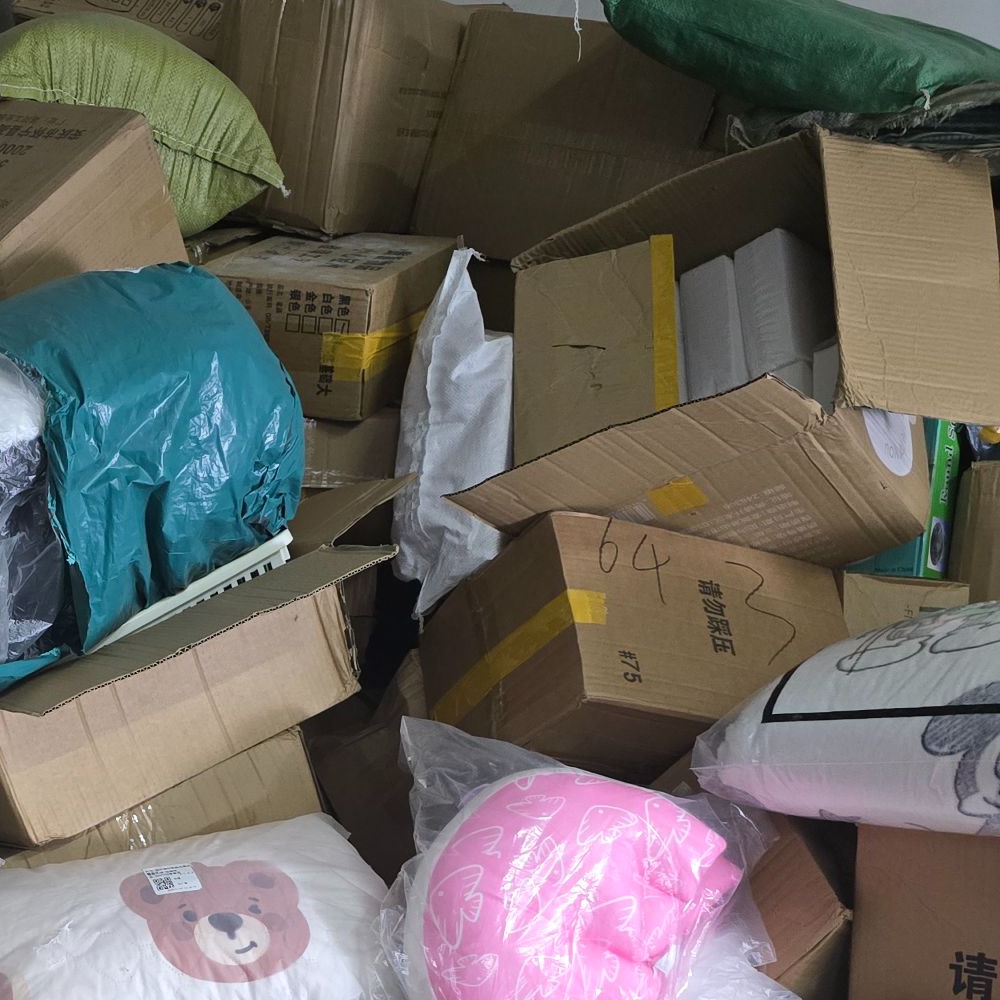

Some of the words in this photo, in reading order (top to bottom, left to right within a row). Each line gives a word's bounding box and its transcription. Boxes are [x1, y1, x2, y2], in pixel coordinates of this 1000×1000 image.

[303, 290, 318, 314] 金色
[320, 292, 335, 316] 白色
[336, 293, 350, 317] 黑色
[598, 516, 672, 606] 64
[697, 578, 736, 657] 请勿踩压
[618, 649, 643, 684] #75
